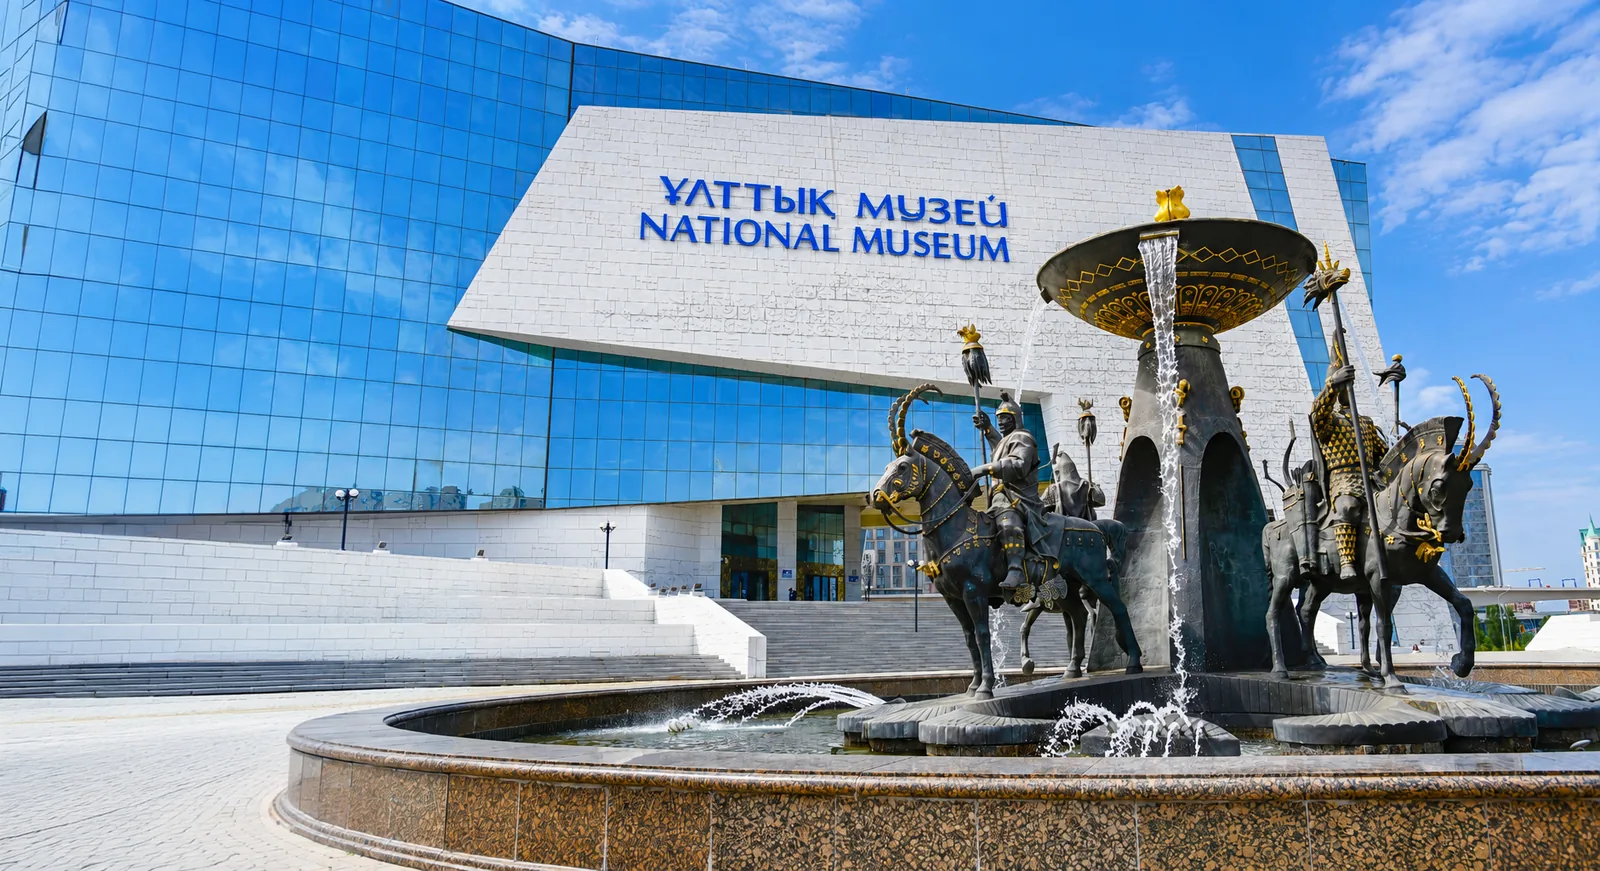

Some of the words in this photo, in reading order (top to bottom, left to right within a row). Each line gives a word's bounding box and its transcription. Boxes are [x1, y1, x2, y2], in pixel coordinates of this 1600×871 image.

[659, 175, 836, 220] ҰЛТТЫҚ
[856, 192, 1009, 228] МУЗЕЙ
[639, 211, 839, 253] NATIONAL
[852, 226, 1010, 263] MUSEUM
